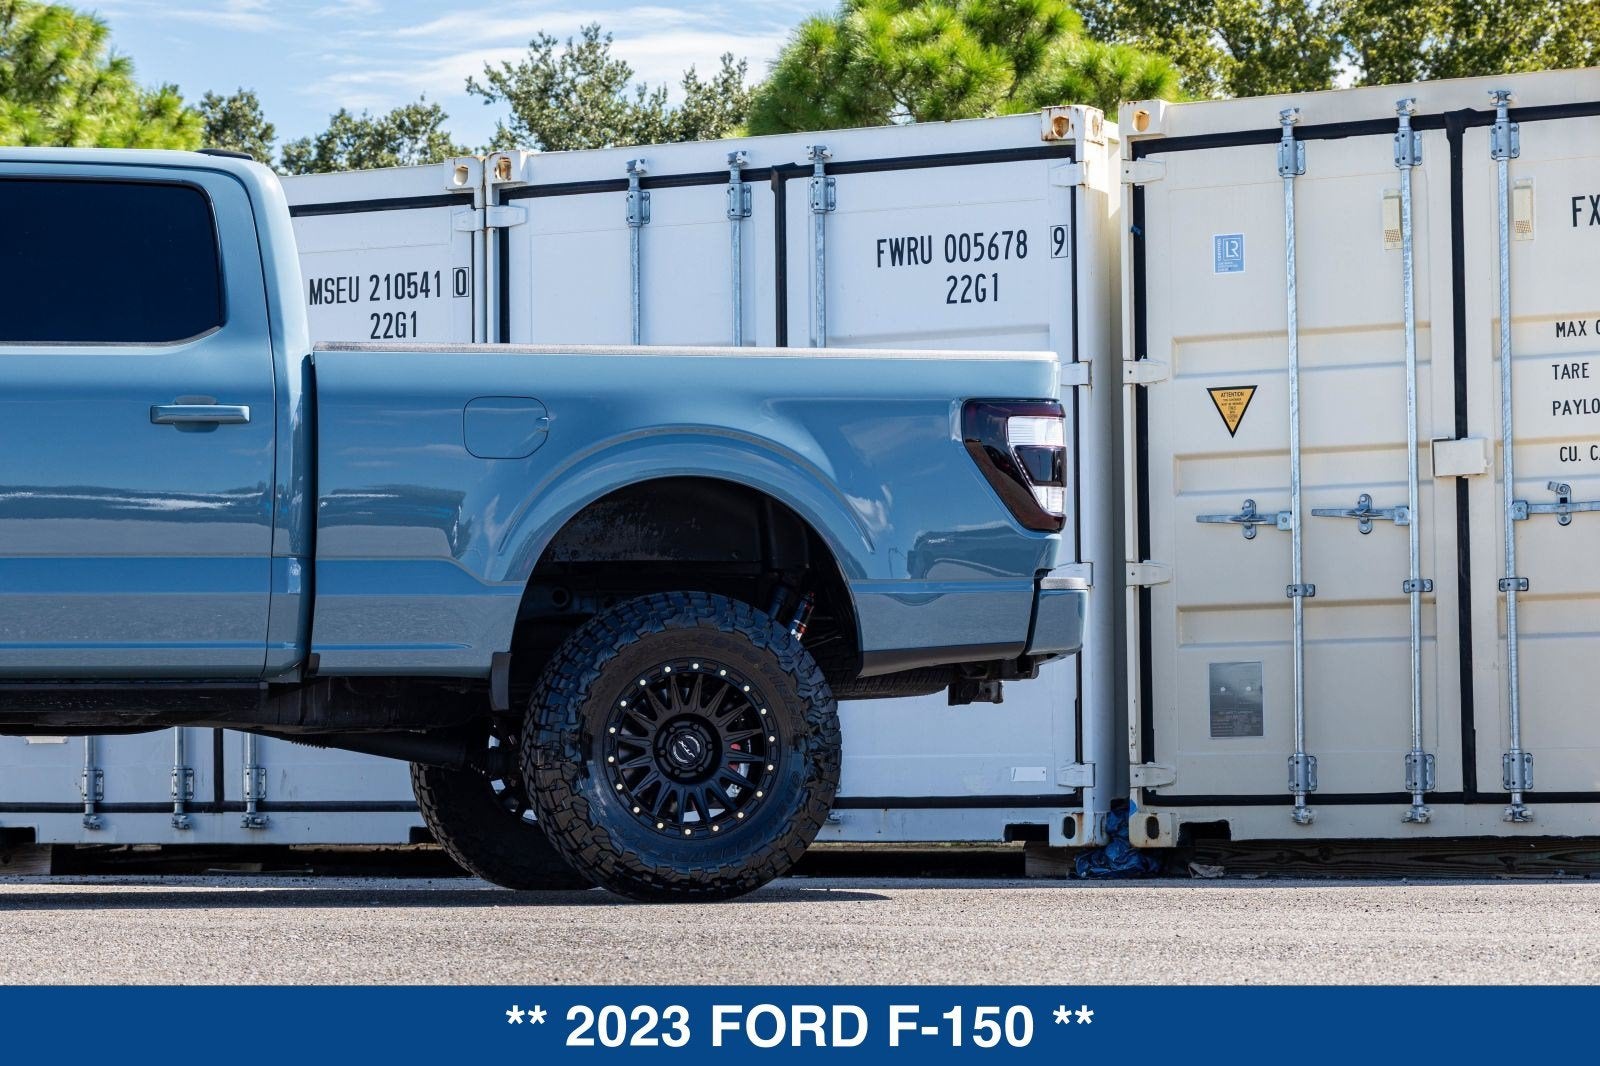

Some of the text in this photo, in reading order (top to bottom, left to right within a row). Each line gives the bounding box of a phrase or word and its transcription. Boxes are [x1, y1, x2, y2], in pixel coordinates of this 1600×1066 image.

[876, 226, 1066, 268] FWRU 005678 9
[309, 269, 467, 306] MSEU 210541 0
[946, 272, 998, 305] 22G1
[370, 310, 417, 340] 22G1
[1555, 320, 1587, 338] MAX
[1551, 362, 1590, 381] TARE
[1559, 445, 1582, 462] CU.
